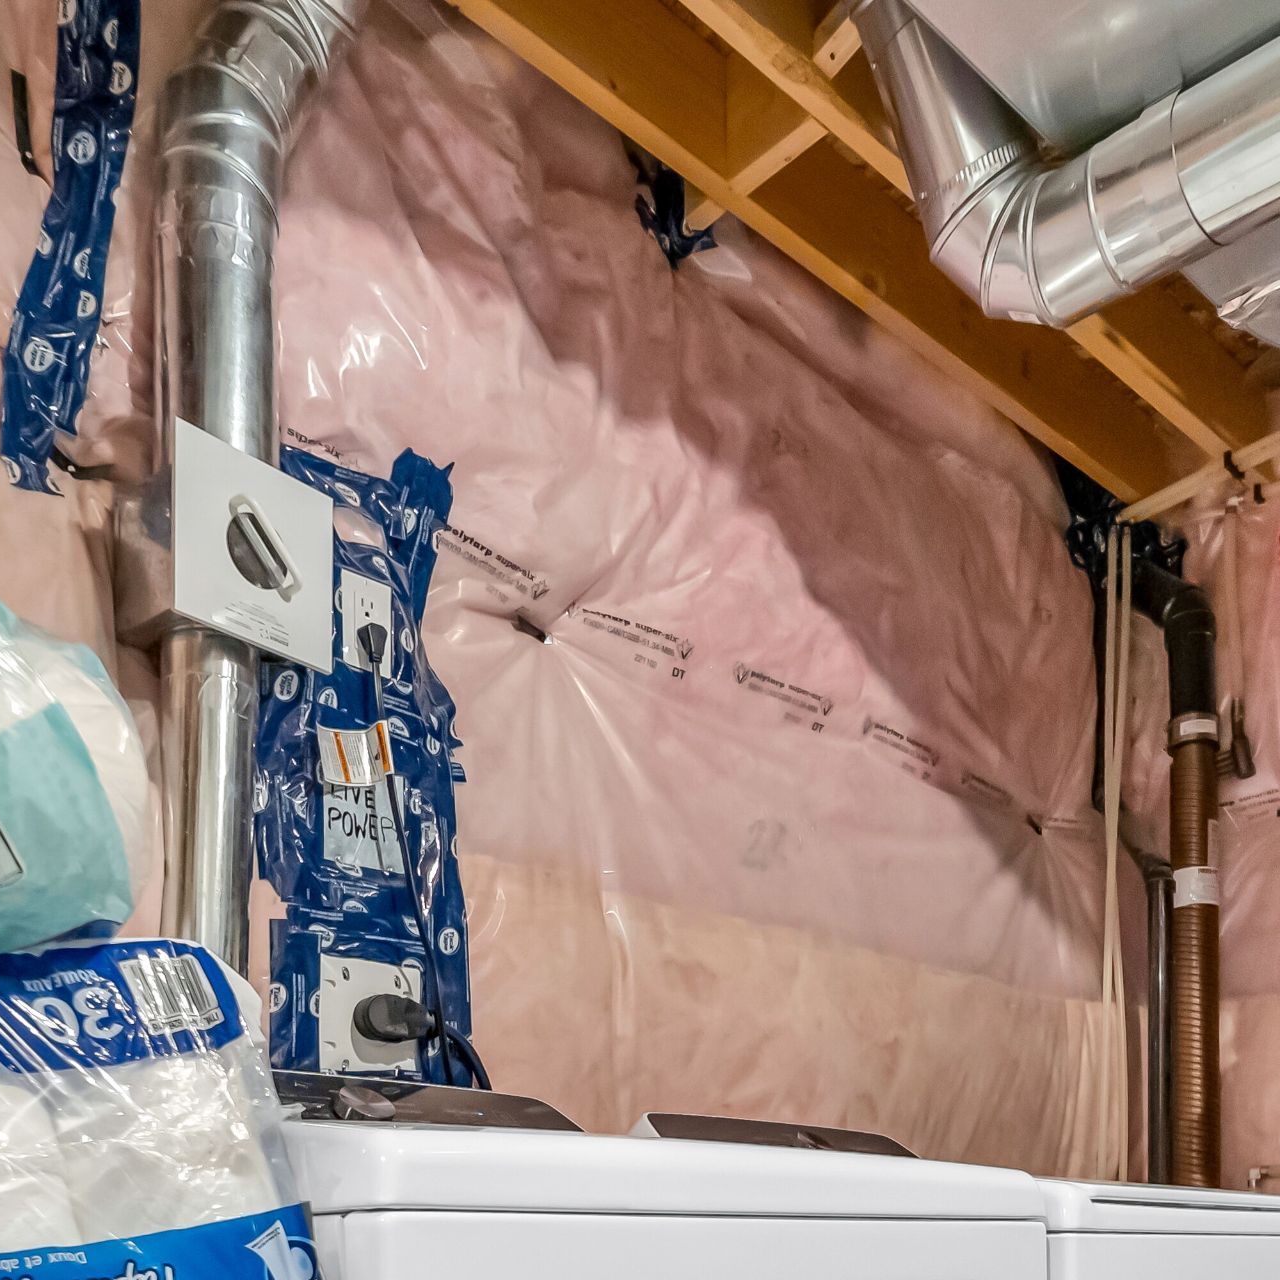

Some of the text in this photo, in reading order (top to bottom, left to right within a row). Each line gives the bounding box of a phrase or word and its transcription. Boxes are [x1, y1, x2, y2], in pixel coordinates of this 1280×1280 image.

[495, 553, 536, 582] super-six
[635, 622, 680, 642] super-six
[671, 666, 686, 680] DT
[328, 806, 400, 843] POWER
[30, 986, 123, 1044] 30
[24, 1253, 42, 1267] et
[48, 1249, 88, 1266] Doux
